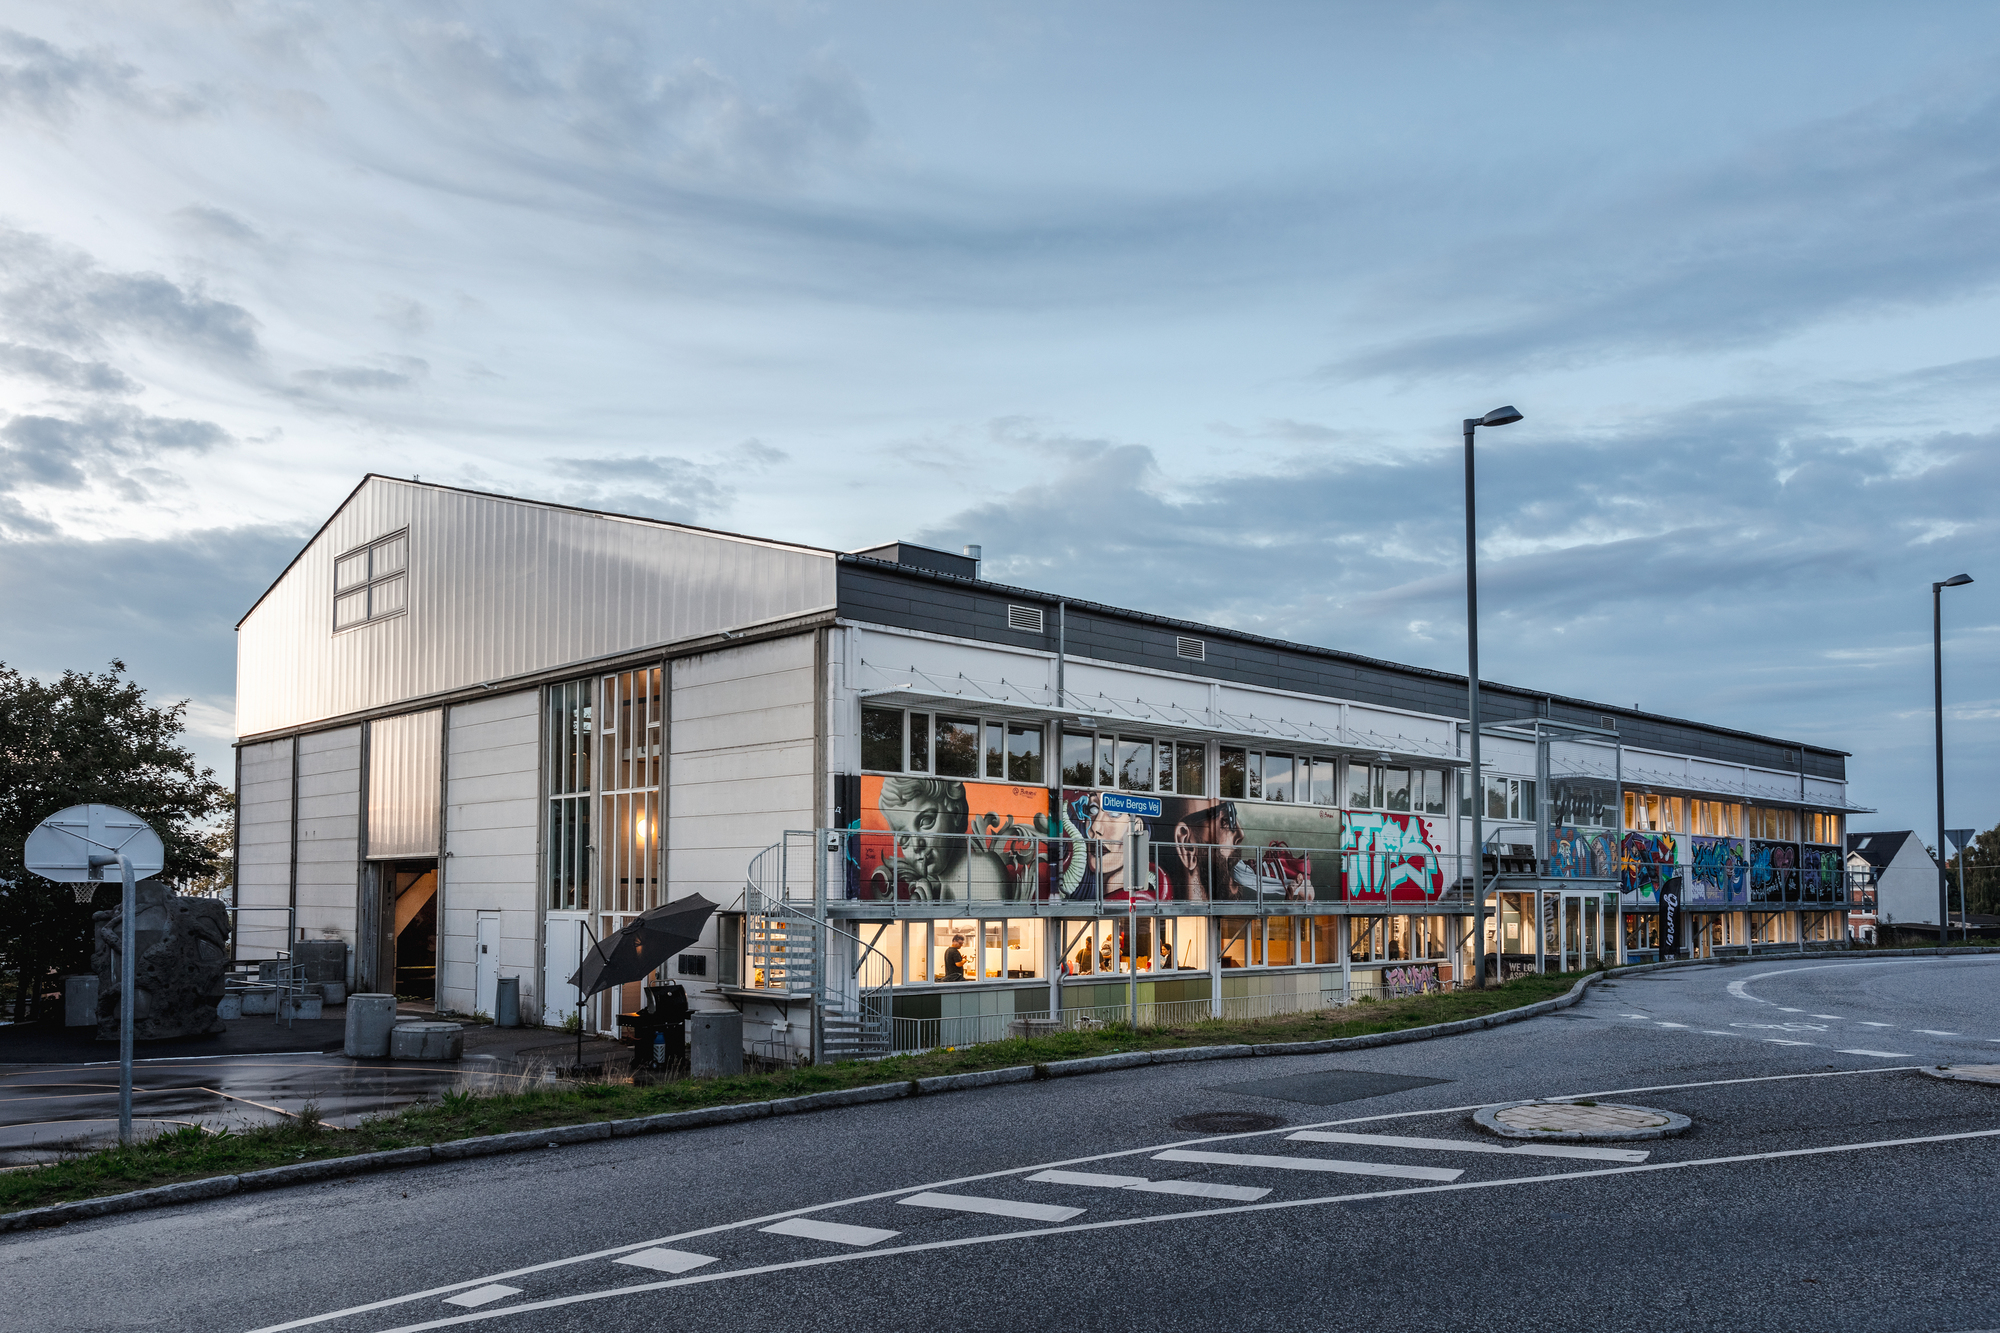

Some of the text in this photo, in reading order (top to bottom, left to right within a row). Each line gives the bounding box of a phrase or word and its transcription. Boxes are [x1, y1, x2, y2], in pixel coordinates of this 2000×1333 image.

[1104, 796, 1159, 814] Ditlev Bergs Vej
[1508, 962, 1536, 972] WE LOV
